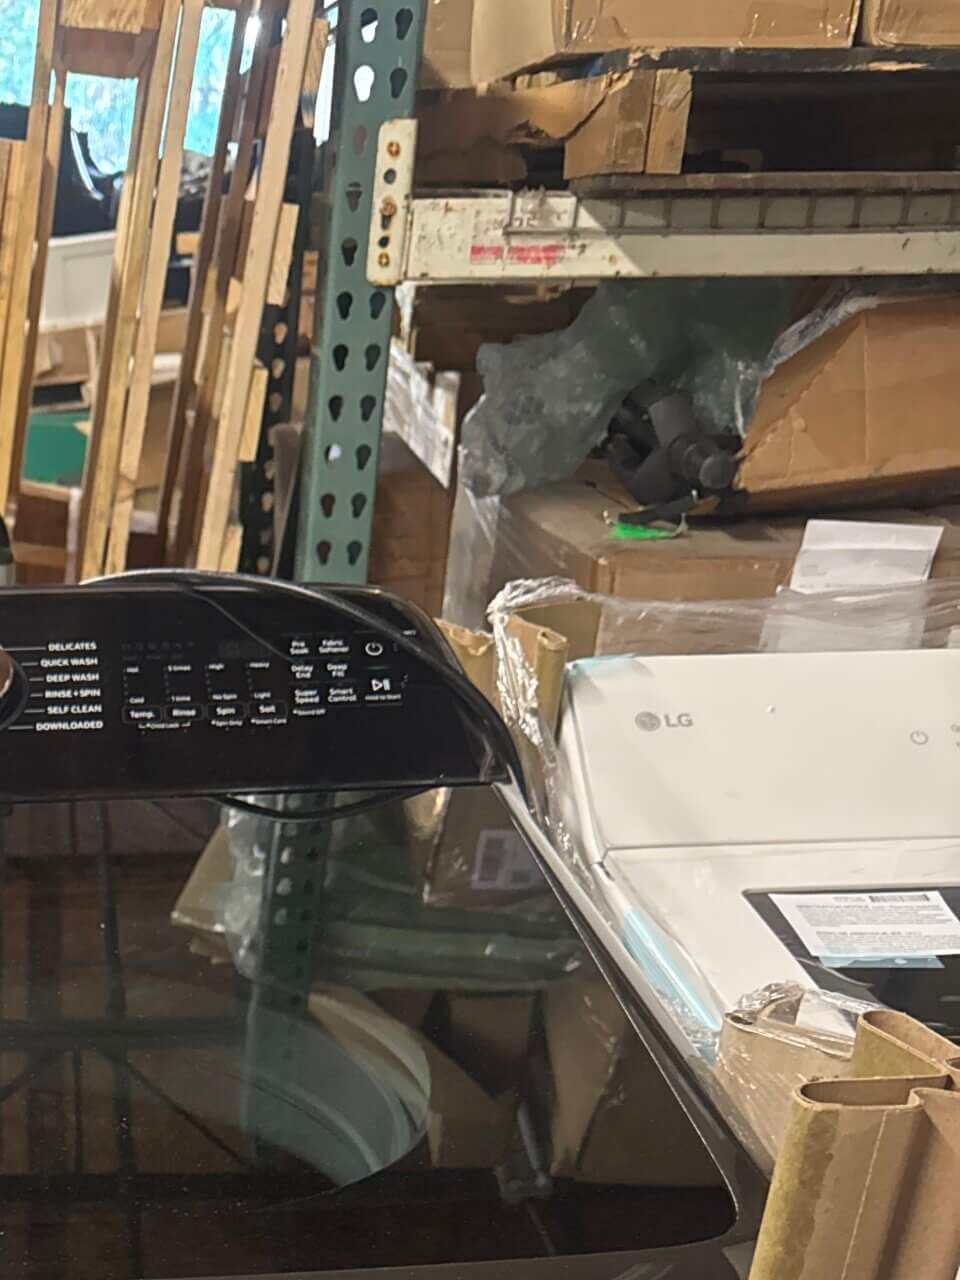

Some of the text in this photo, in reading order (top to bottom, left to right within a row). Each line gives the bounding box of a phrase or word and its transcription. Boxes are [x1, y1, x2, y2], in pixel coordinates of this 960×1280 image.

[48, 642, 97, 652] DELICATES
[40, 657, 98, 667] QUICK WASH
[46, 672, 100, 683] DEEP WASH
[295, 671, 311, 679] End
[45, 689, 73, 698] RINSE
[79, 688, 101, 697] SPIN
[47, 704, 102, 715] SELF CLEAN
[216, 706, 236, 716] Spin
[663, 712, 694, 728] LG
[36, 720, 104, 731] DOWNLOADED
